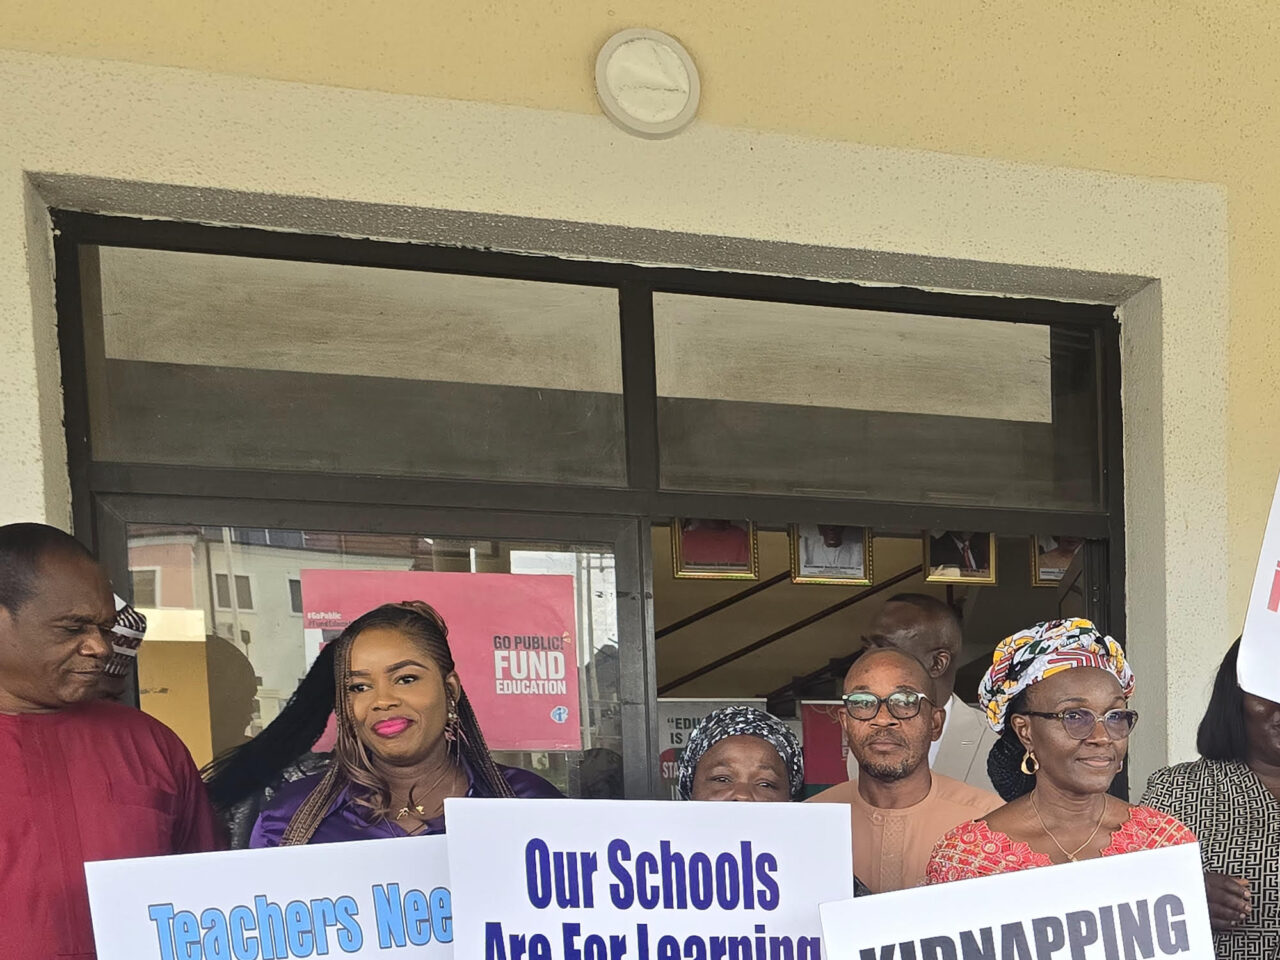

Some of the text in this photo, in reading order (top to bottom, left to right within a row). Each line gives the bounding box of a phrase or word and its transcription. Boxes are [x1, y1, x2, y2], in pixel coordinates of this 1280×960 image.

[494, 635, 564, 650] GO PUBLIC!
[494, 650, 566, 680] FUND
[496, 680, 567, 695] EDUCATION
[670, 732, 683, 745] IS
[525, 838, 780, 910] Our Schools
[372, 883, 454, 949] Nee
